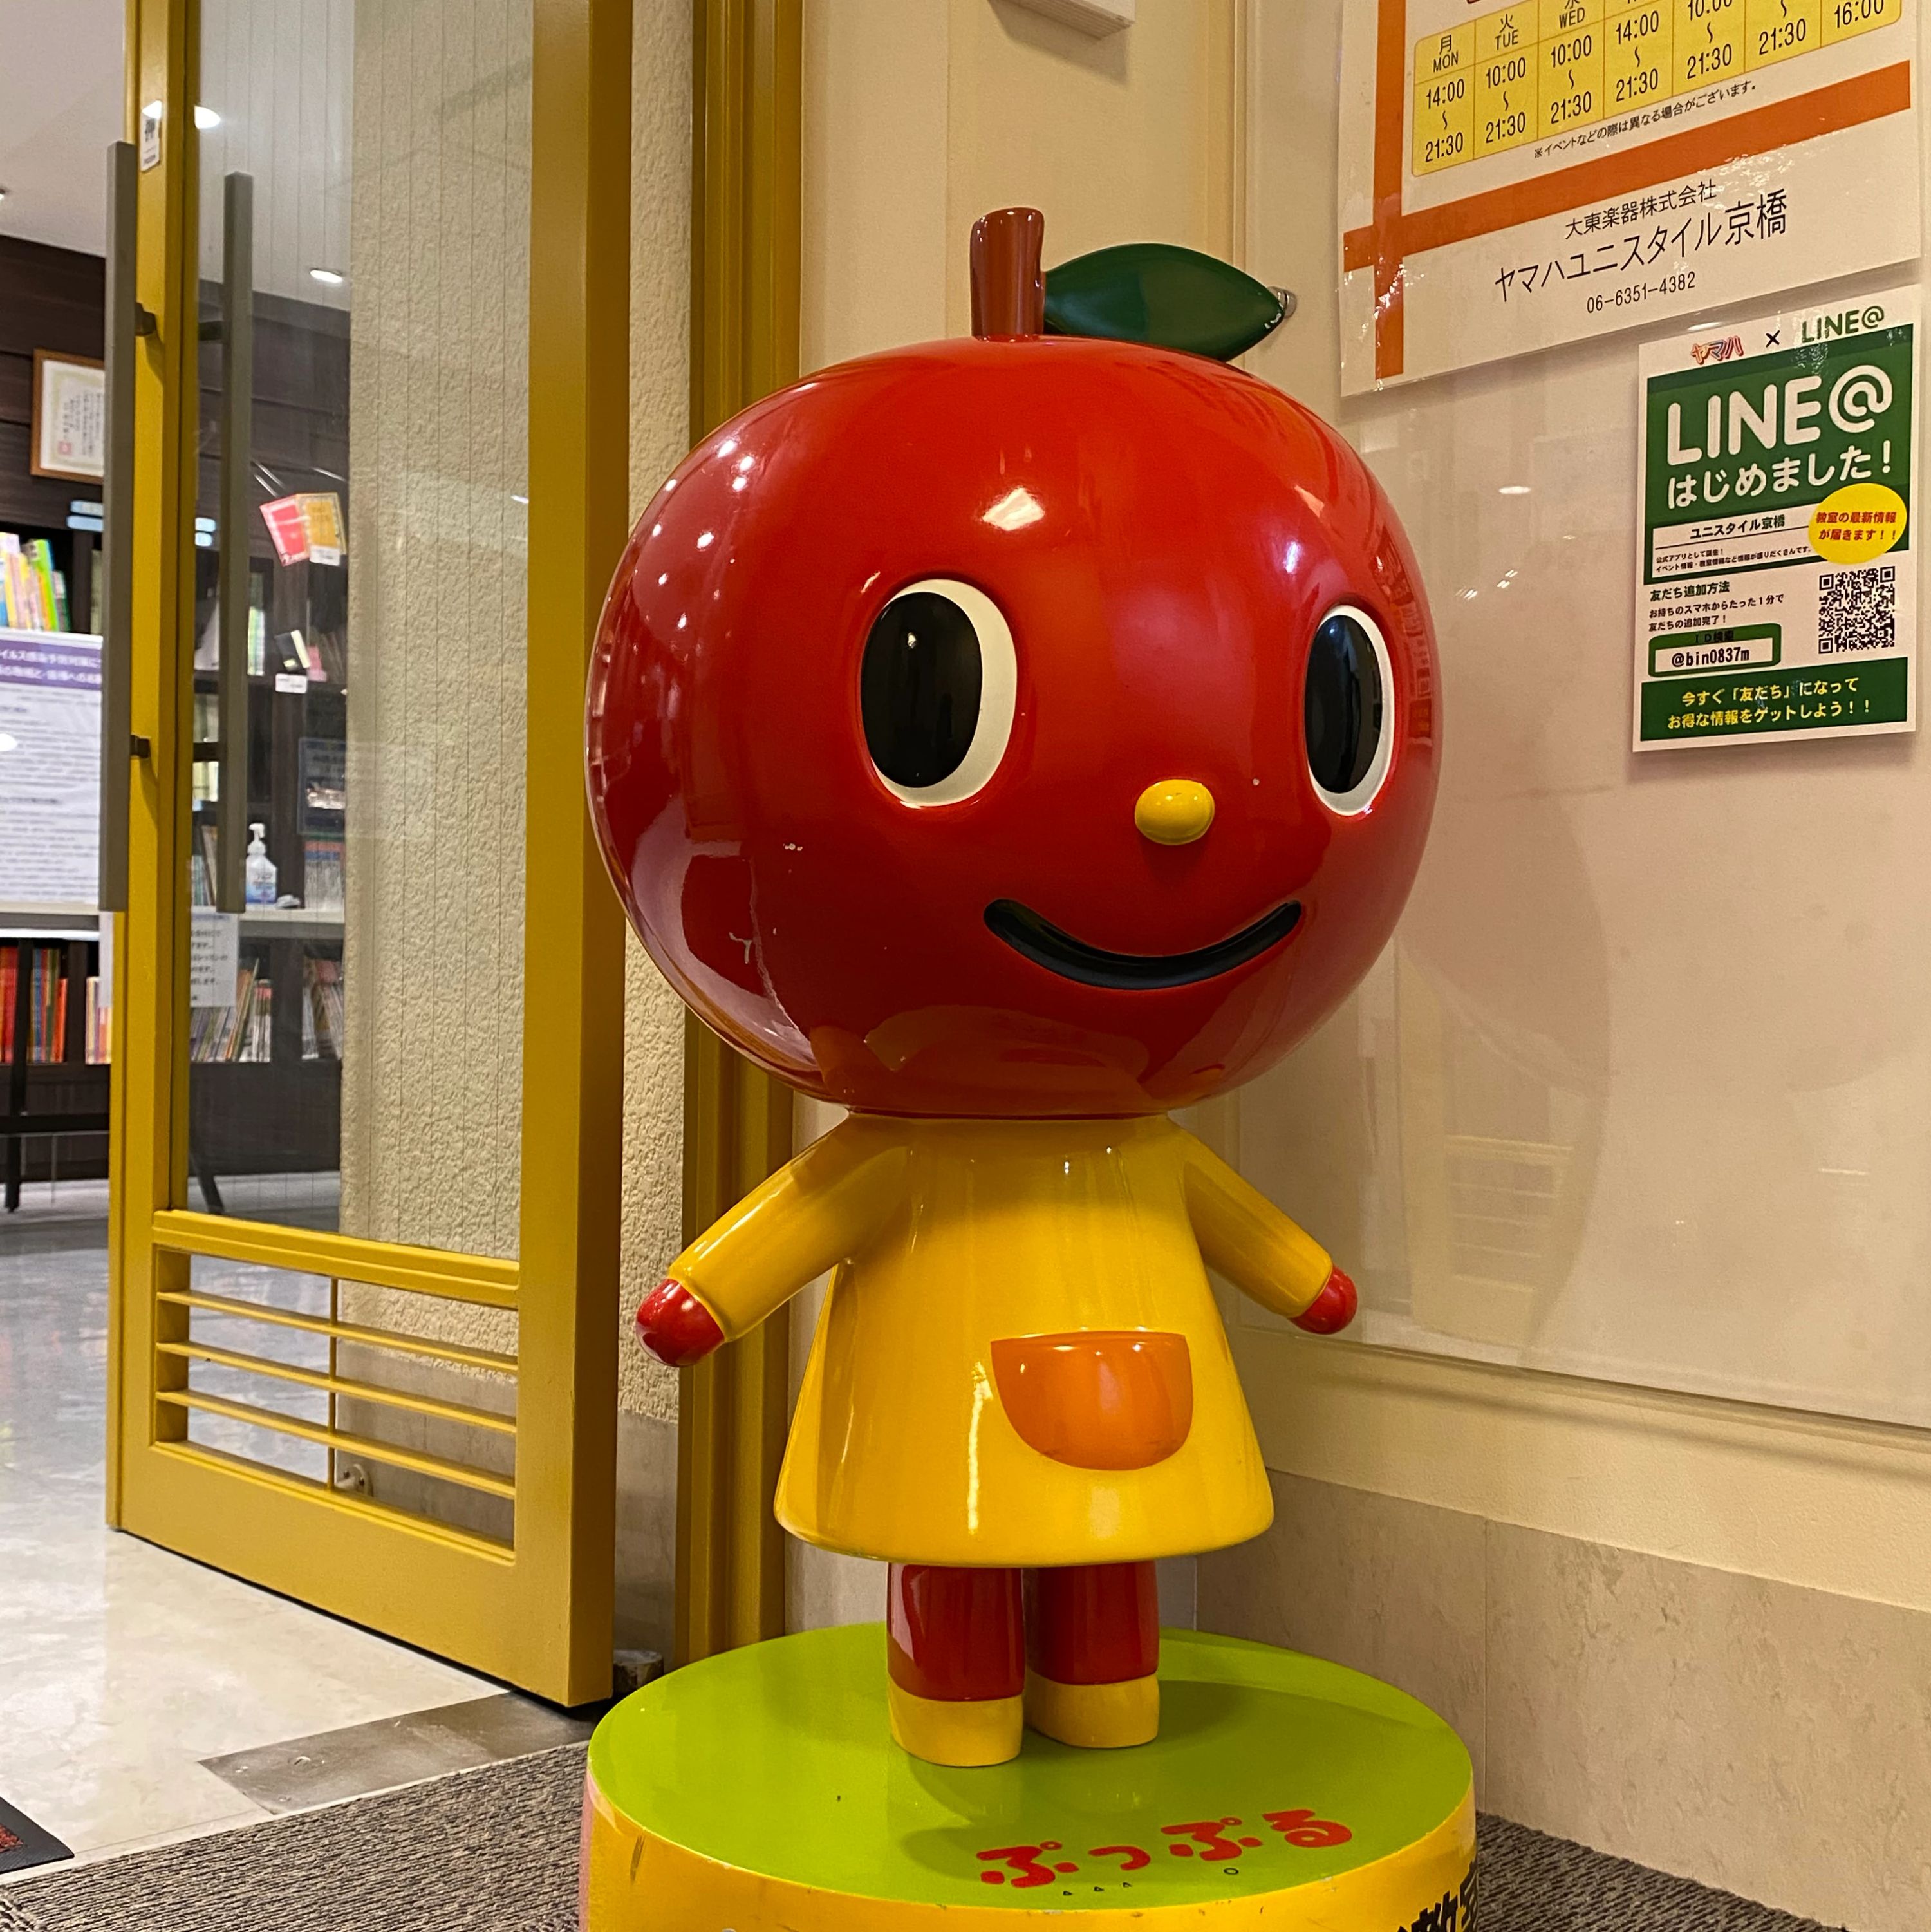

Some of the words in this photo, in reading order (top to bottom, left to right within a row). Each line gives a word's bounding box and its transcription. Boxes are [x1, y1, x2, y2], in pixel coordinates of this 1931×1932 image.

[1500, 14, 1514, 32] 火
[1559, 7, 1585, 29] WED
[1616, 10, 1659, 46] 14:00
[1439, 35, 1451, 55] 月
[1495, 29, 1518, 50] TUE
[1551, 35, 1592, 68] 10:00
[1759, 18, 1805, 55] 21:30
[1433, 51, 1459, 73] MON
[1486, 57, 1526, 89] 10:00
[1686, 43, 1732, 79] 21:30
[1426, 79, 1465, 109] 14:00
[1616, 68, 1659, 102] 21:30
[1551, 91, 1592, 124] 21:30
[1486, 111, 1525, 144] 21:30
[1425, 132, 1463, 162] 21:30
[1565, 179, 1717, 240] 大東楽器株式会社
[1495, 188, 1787, 302] ヤマハユニスタイル京橋
[1587, 271, 1695, 313] 06-6351-4382
[1691, 335, 1744, 364] ヤマハ
[1802, 305, 1885, 343] LINE@
[1667, 364, 1893, 465] LINE@
[1690, 514, 1785, 539] ユニスタイル京橋
[1816, 511, 1897, 523] 教室の最新情報
[1650, 580, 1730, 602] 友だち追加方法
[1672, 646, 1750, 668] @bin0837m
